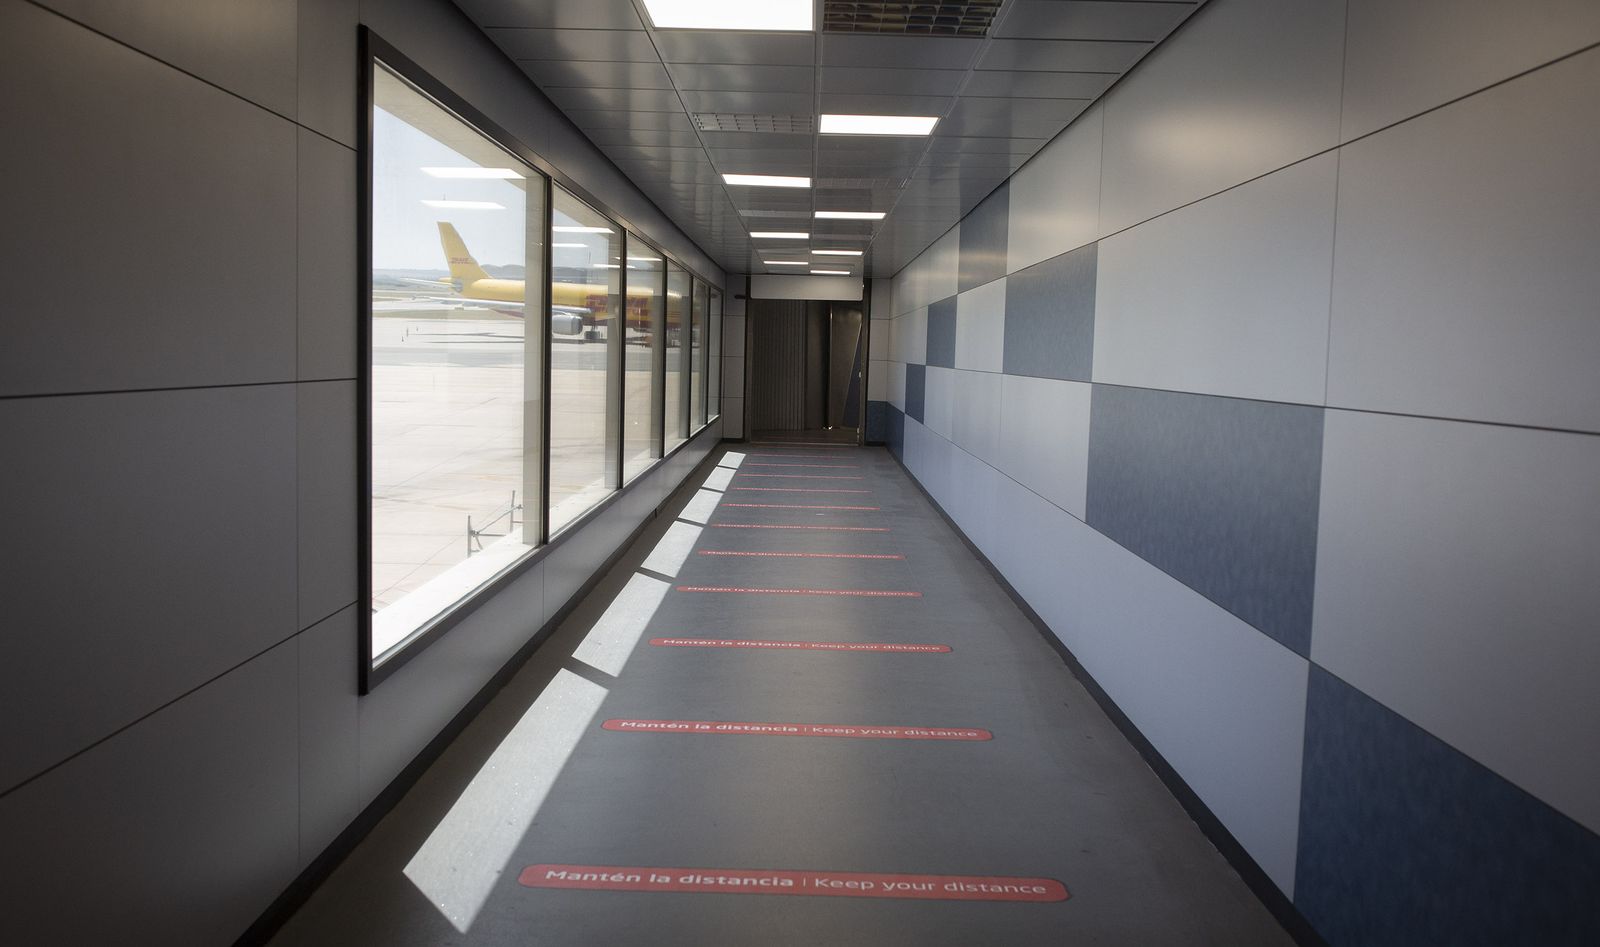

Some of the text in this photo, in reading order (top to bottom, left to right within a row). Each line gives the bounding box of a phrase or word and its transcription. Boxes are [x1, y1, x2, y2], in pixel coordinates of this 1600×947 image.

[619, 721, 690, 729] Mantén
[715, 724, 799, 732] distancia
[903, 729, 978, 737] distance
[544, 870, 1047, 894] Mantén la distancia Keep your distance
